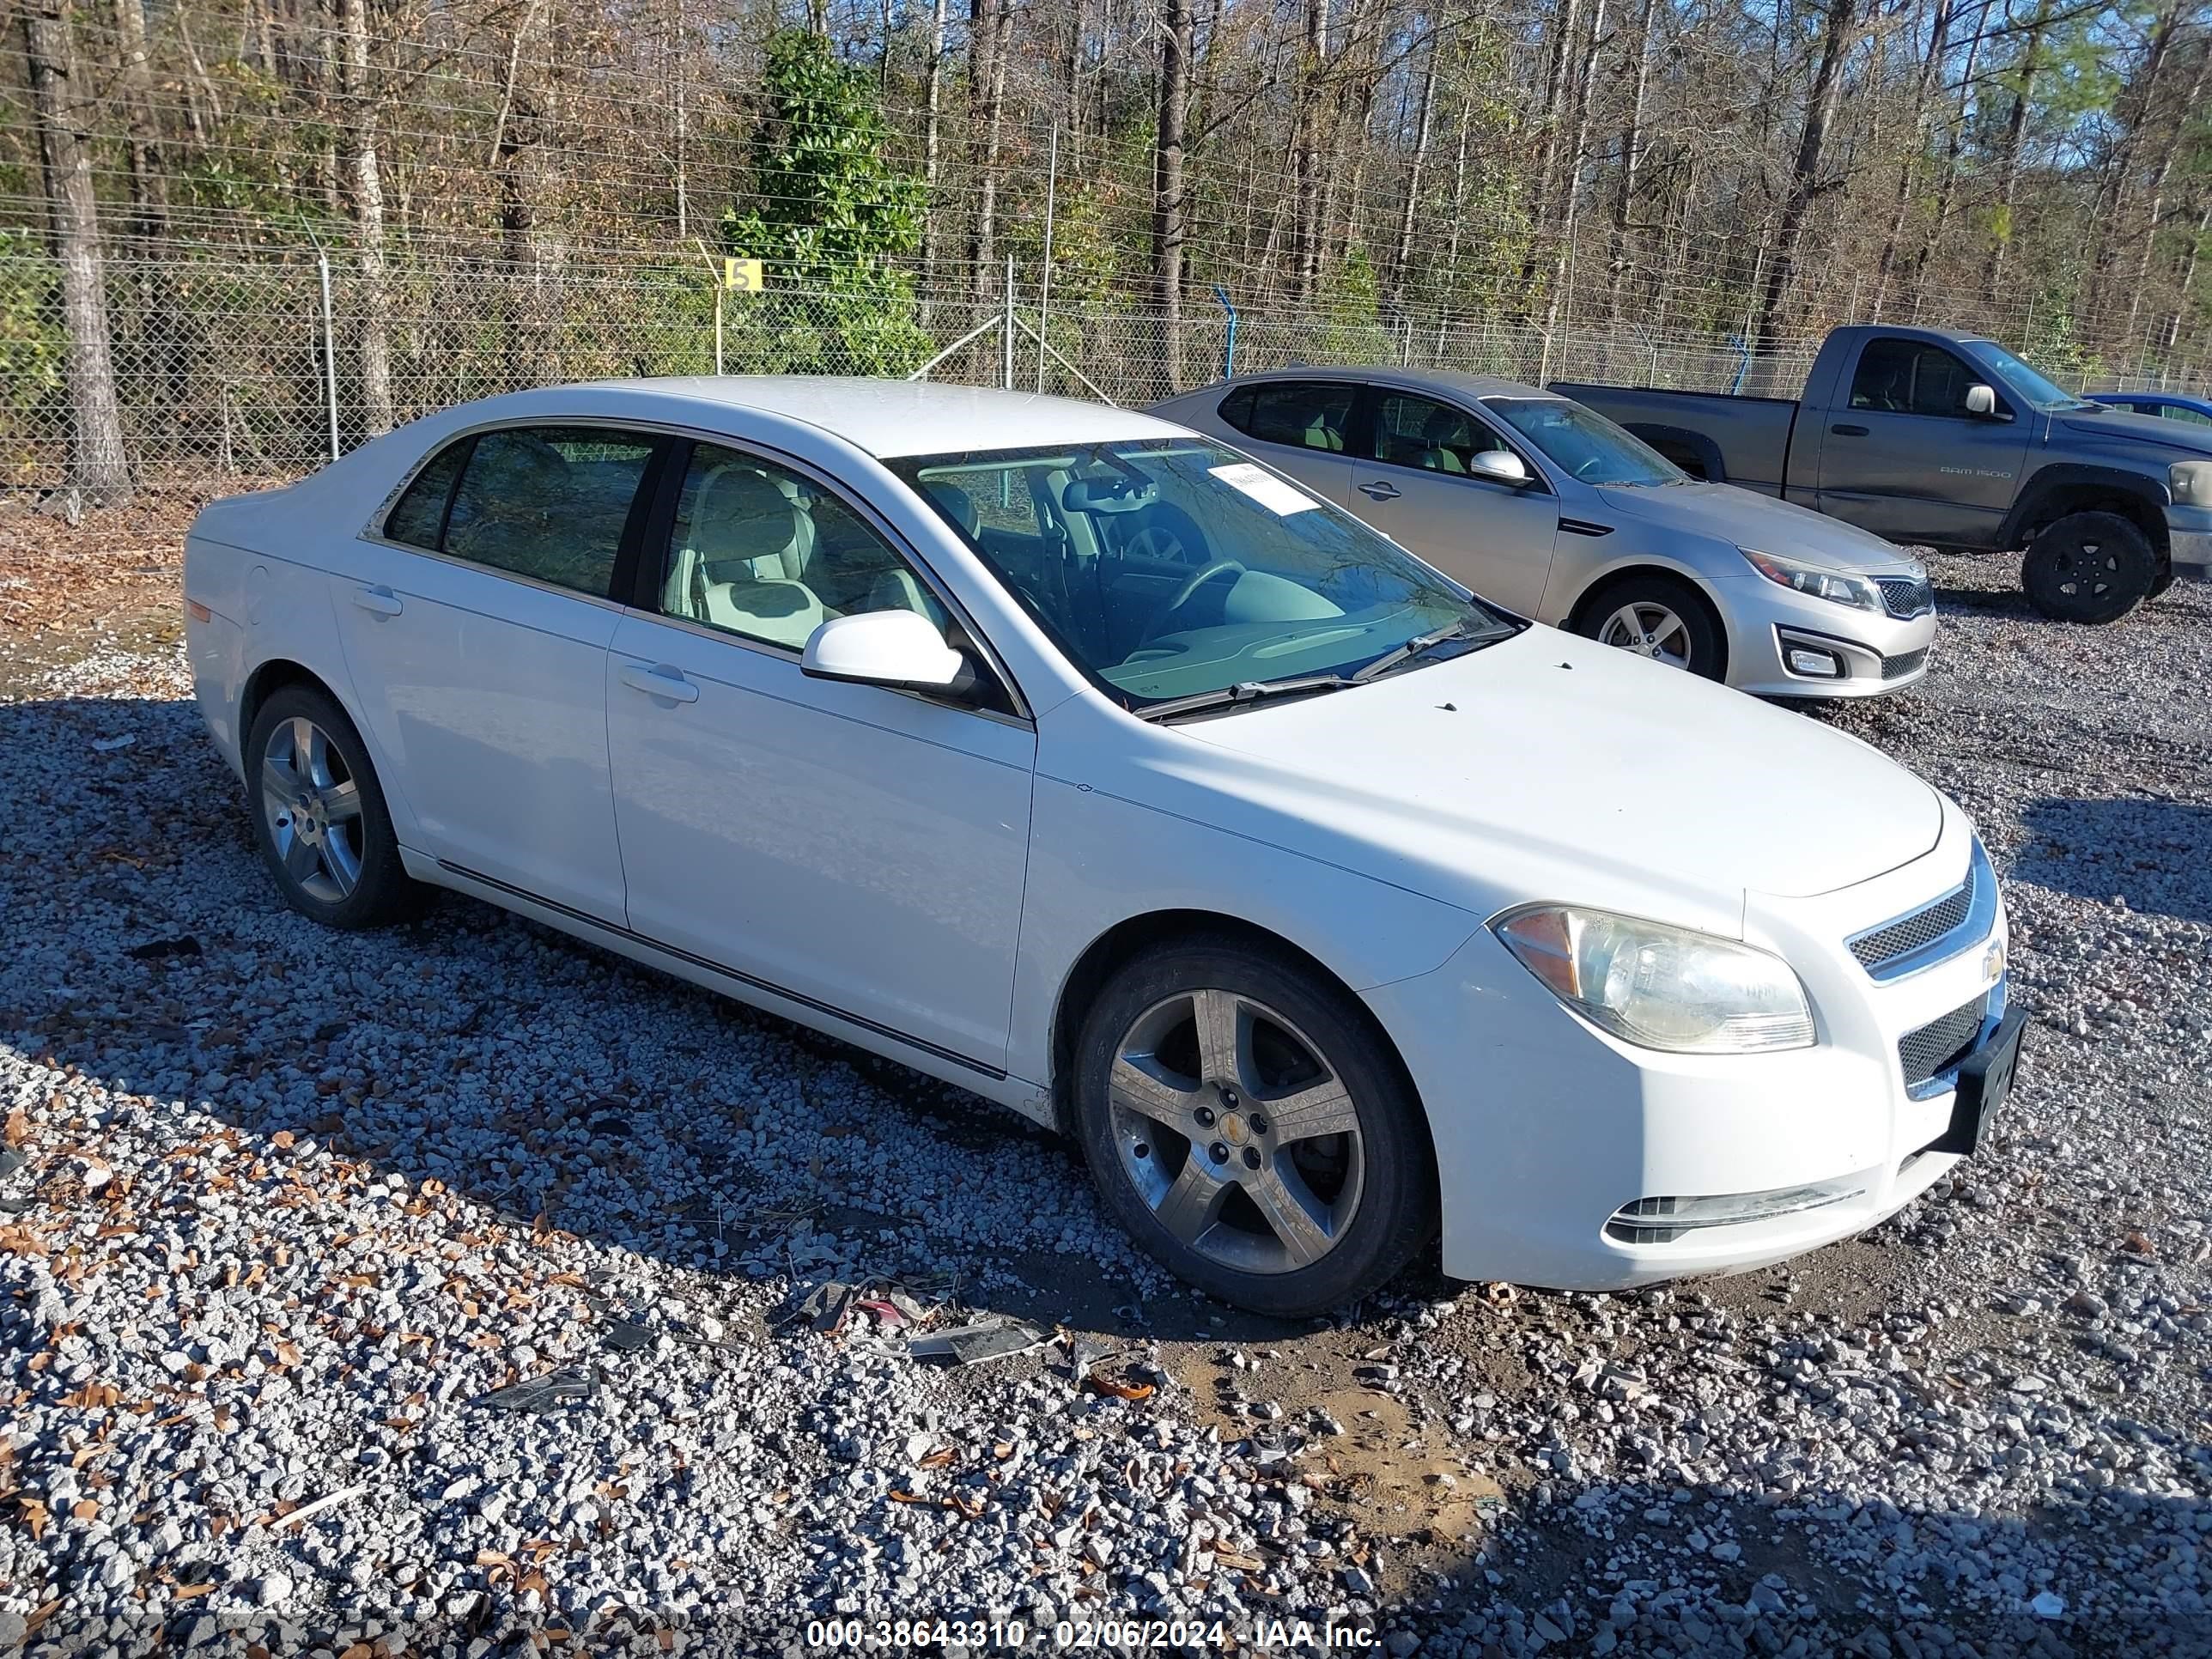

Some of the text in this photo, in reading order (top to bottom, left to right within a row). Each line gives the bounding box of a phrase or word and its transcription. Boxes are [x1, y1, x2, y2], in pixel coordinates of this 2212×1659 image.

[730, 260, 750, 289] 5
[1941, 466, 2011, 478] RAM 1500
